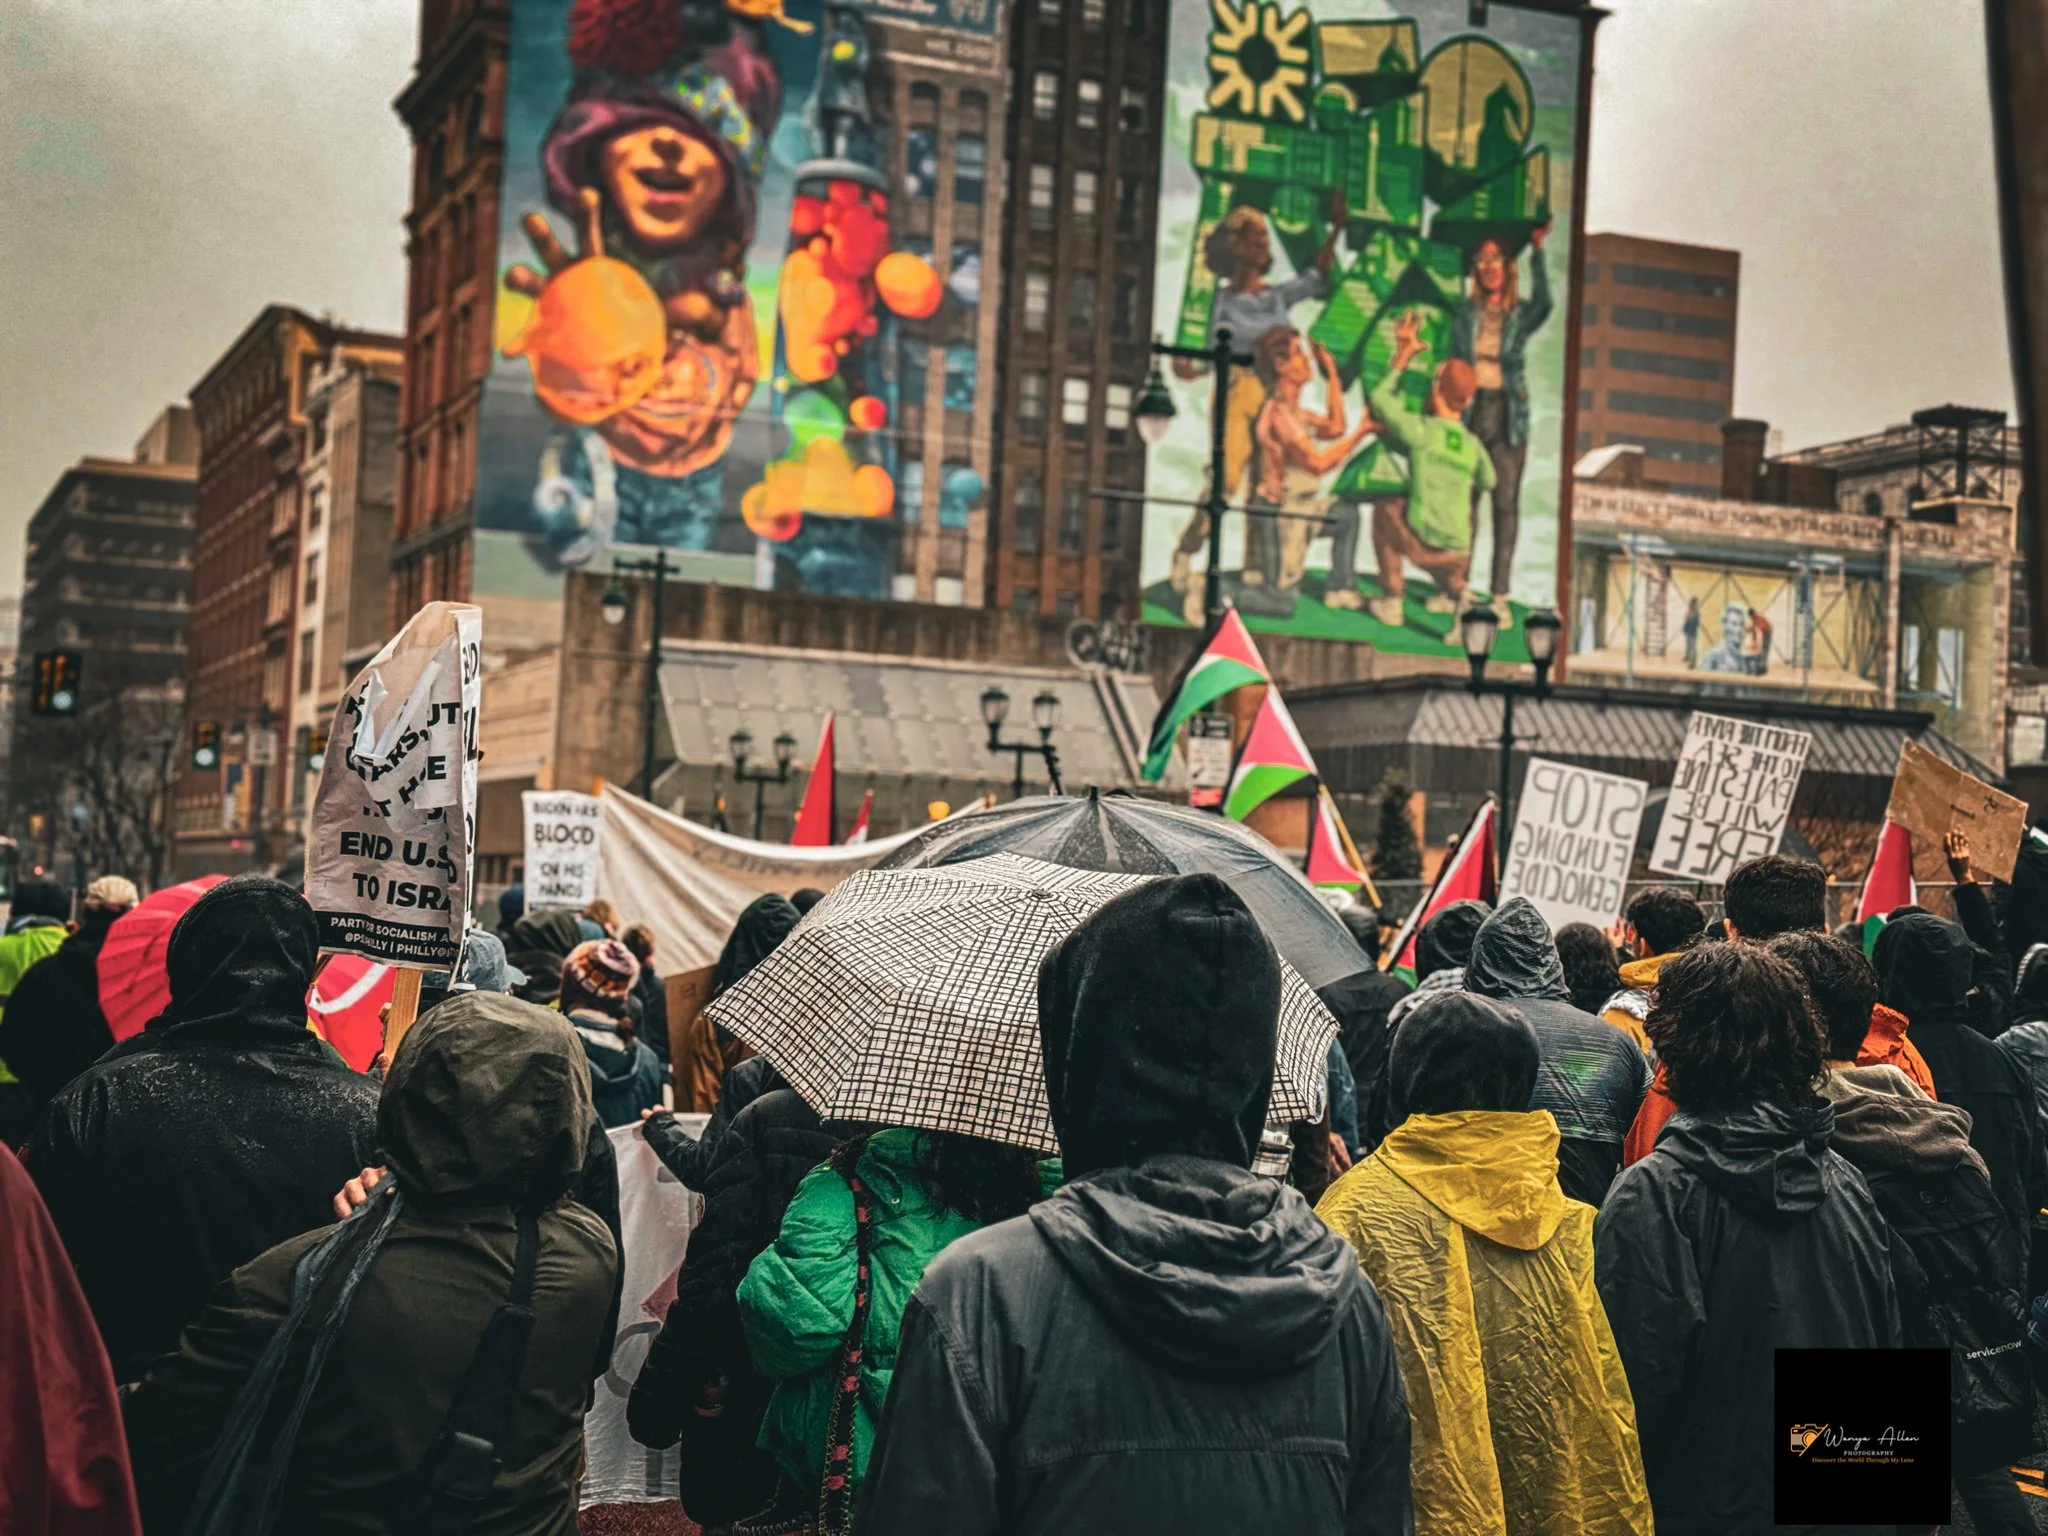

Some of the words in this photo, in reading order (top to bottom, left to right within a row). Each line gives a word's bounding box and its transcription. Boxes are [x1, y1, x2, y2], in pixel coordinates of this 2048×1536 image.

[340, 832, 393, 861] END
[534, 823, 595, 845] BLOOD
[352, 872, 379, 901] TO
[331, 917, 365, 929] PARTY
[376, 924, 437, 943] SOCIALISM
[1966, 1339, 2022, 1360] servicenow
